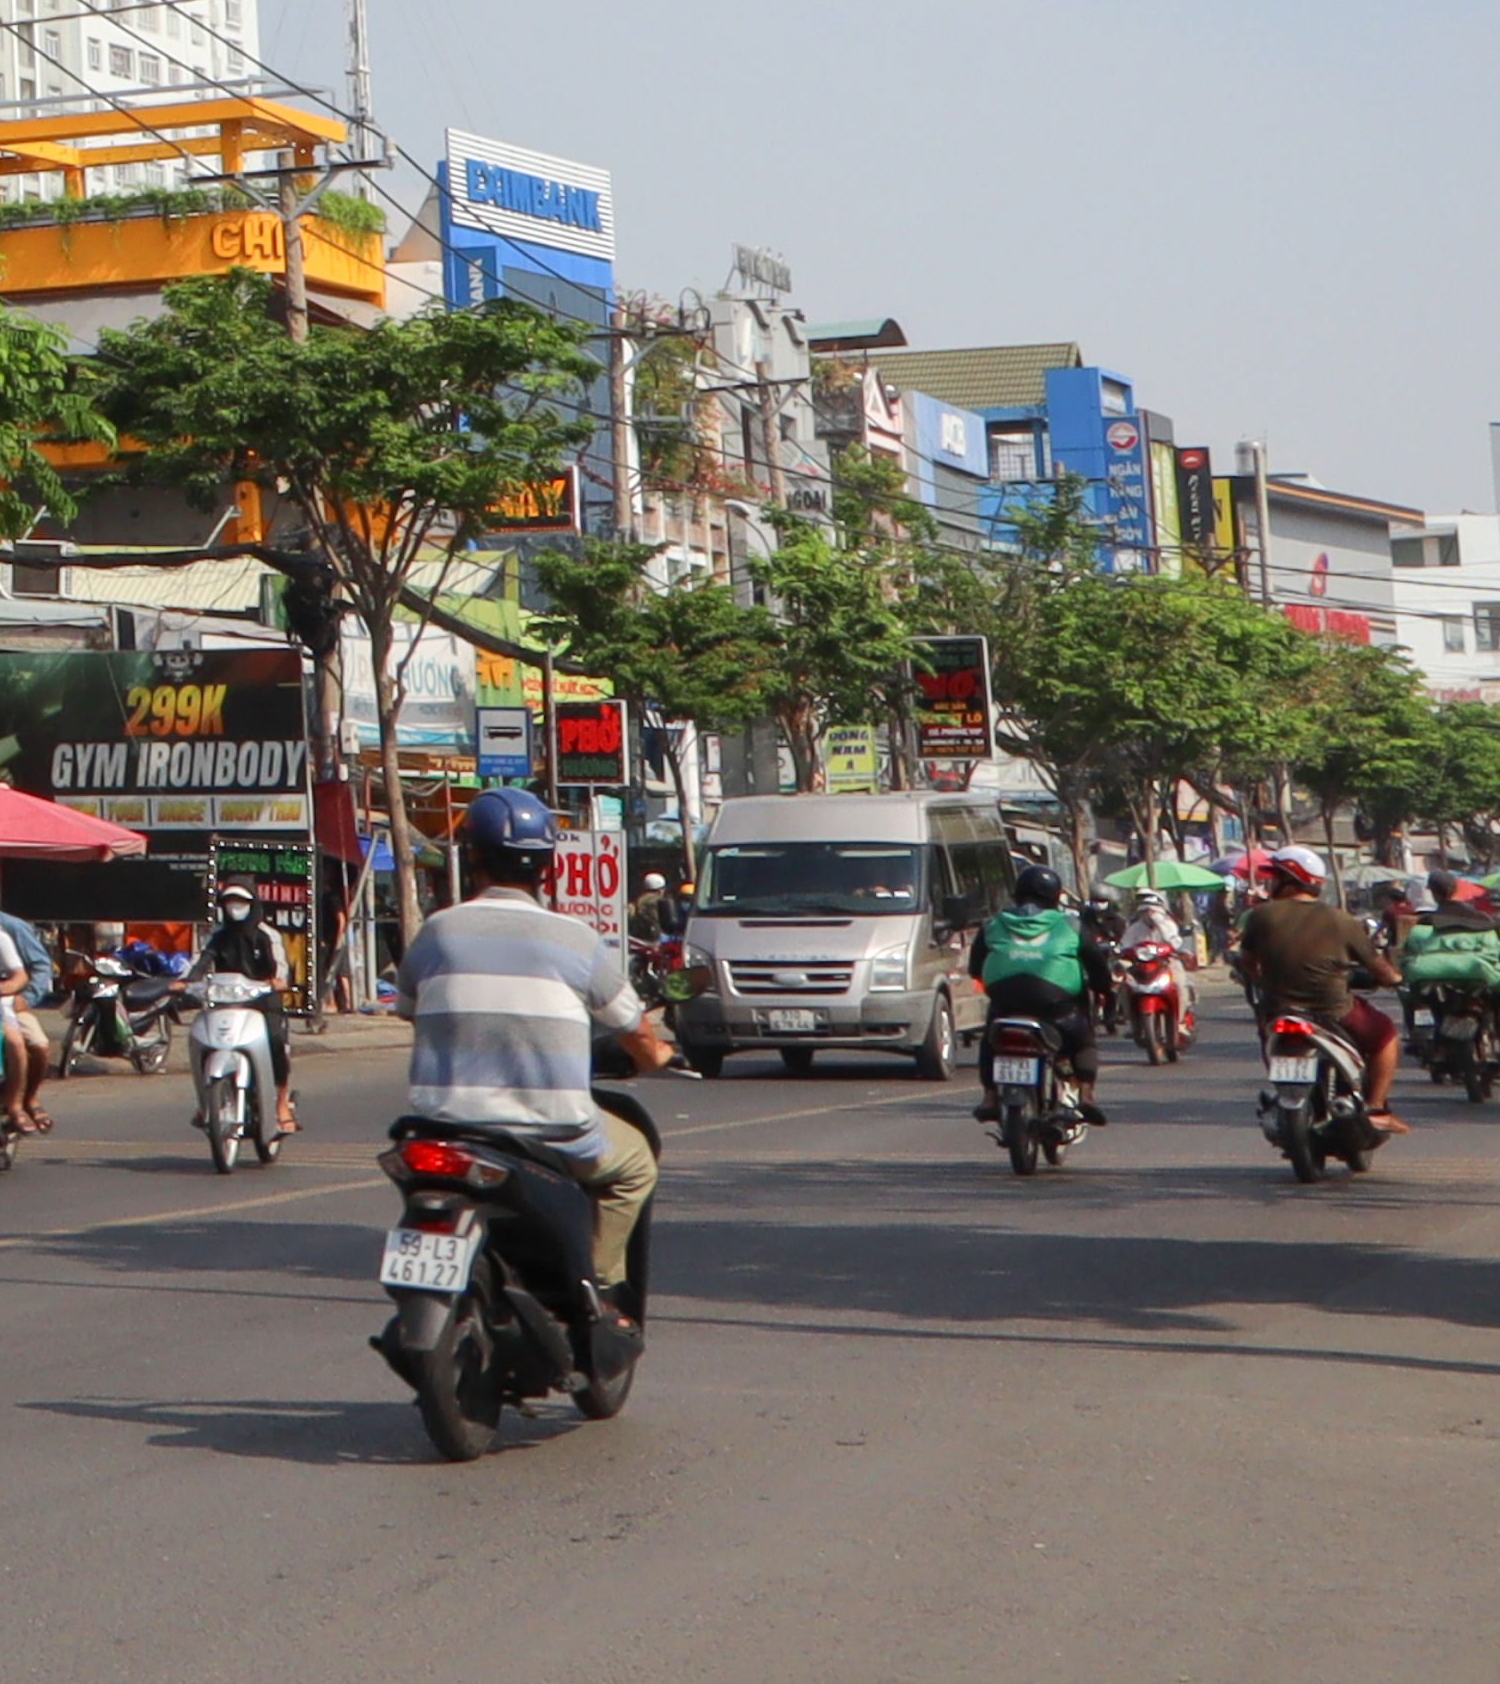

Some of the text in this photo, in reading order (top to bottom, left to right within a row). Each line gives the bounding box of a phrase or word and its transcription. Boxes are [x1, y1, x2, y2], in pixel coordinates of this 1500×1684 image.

[465, 157, 602, 235] EXIMBANK
[123, 684, 228, 737] 299K
[51, 740, 307, 789] GYM IRONBODY
[398, 1232, 458, 1261] 59-L3
[388, 1257, 460, 1287] 461.27
